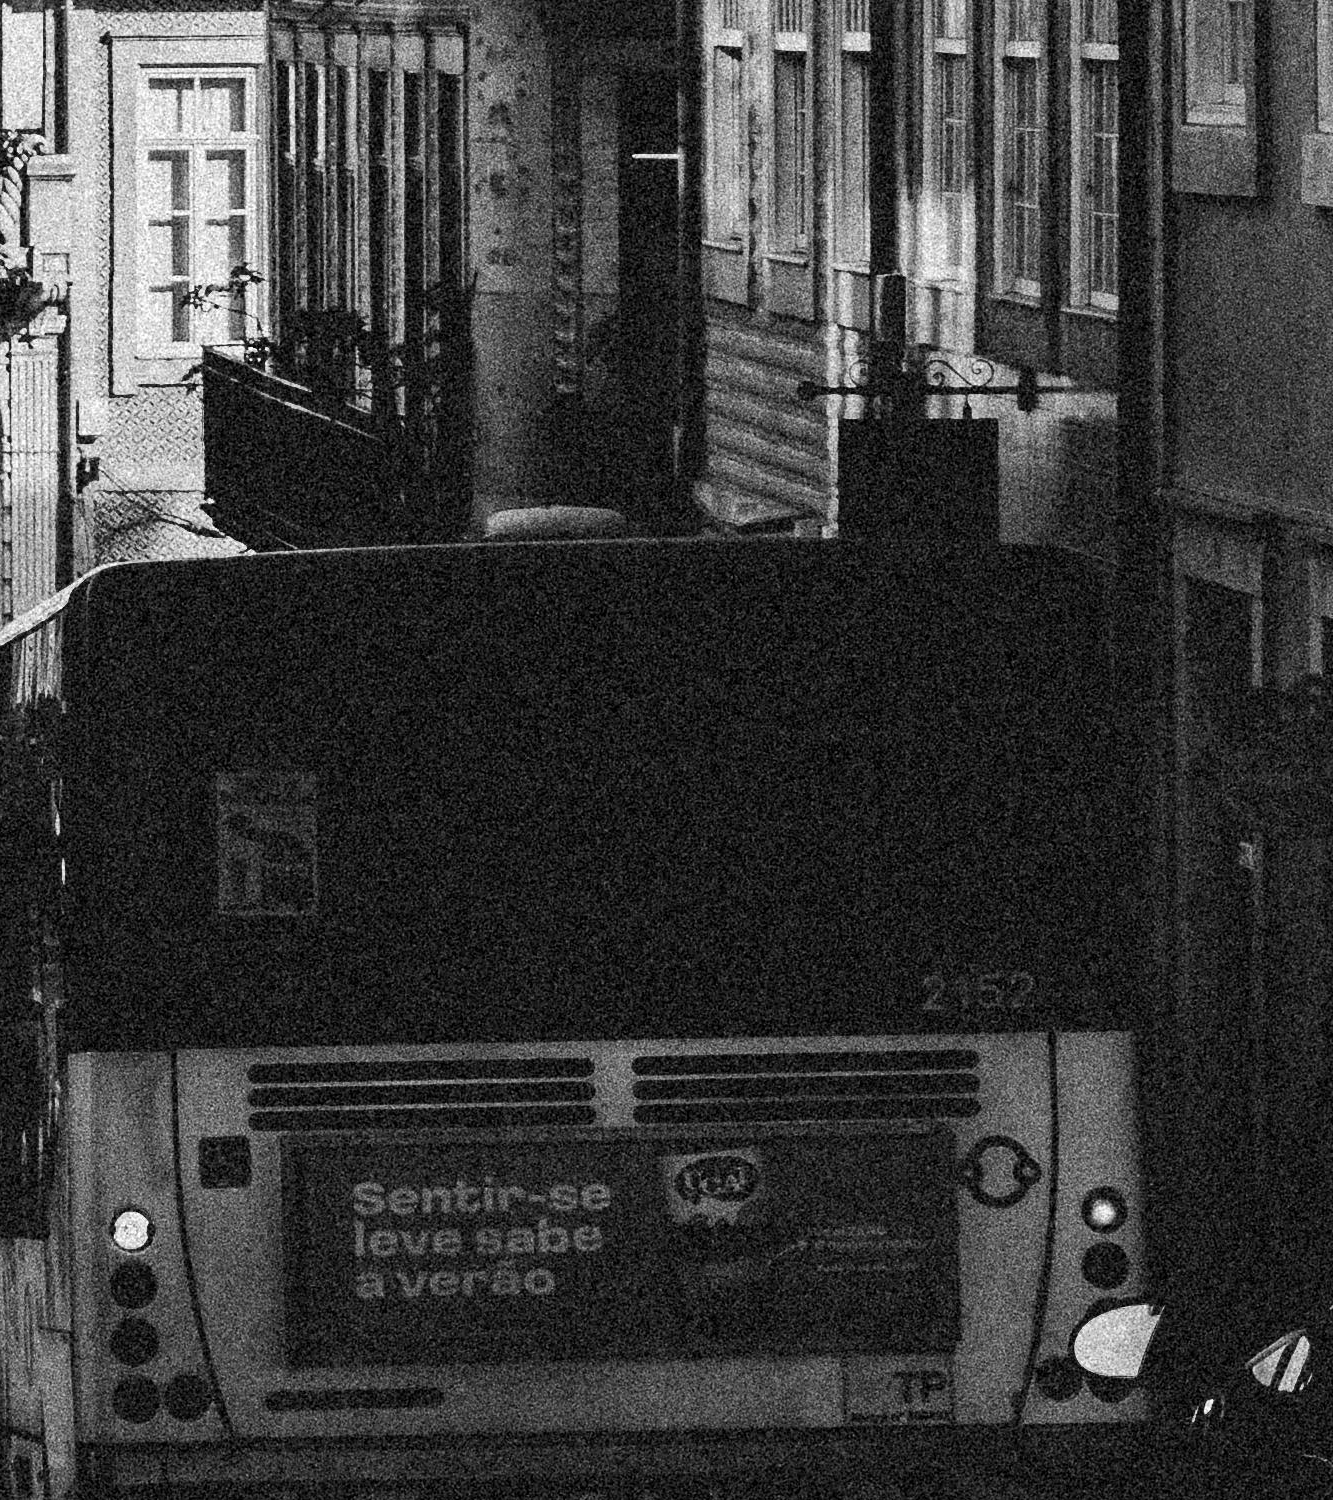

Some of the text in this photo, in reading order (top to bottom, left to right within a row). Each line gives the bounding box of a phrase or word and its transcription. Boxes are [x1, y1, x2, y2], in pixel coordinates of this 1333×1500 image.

[351, 1177, 614, 1218] Sentir-se
[352, 1216, 607, 1258] leve sabe
[354, 1260, 558, 1300] a verão
